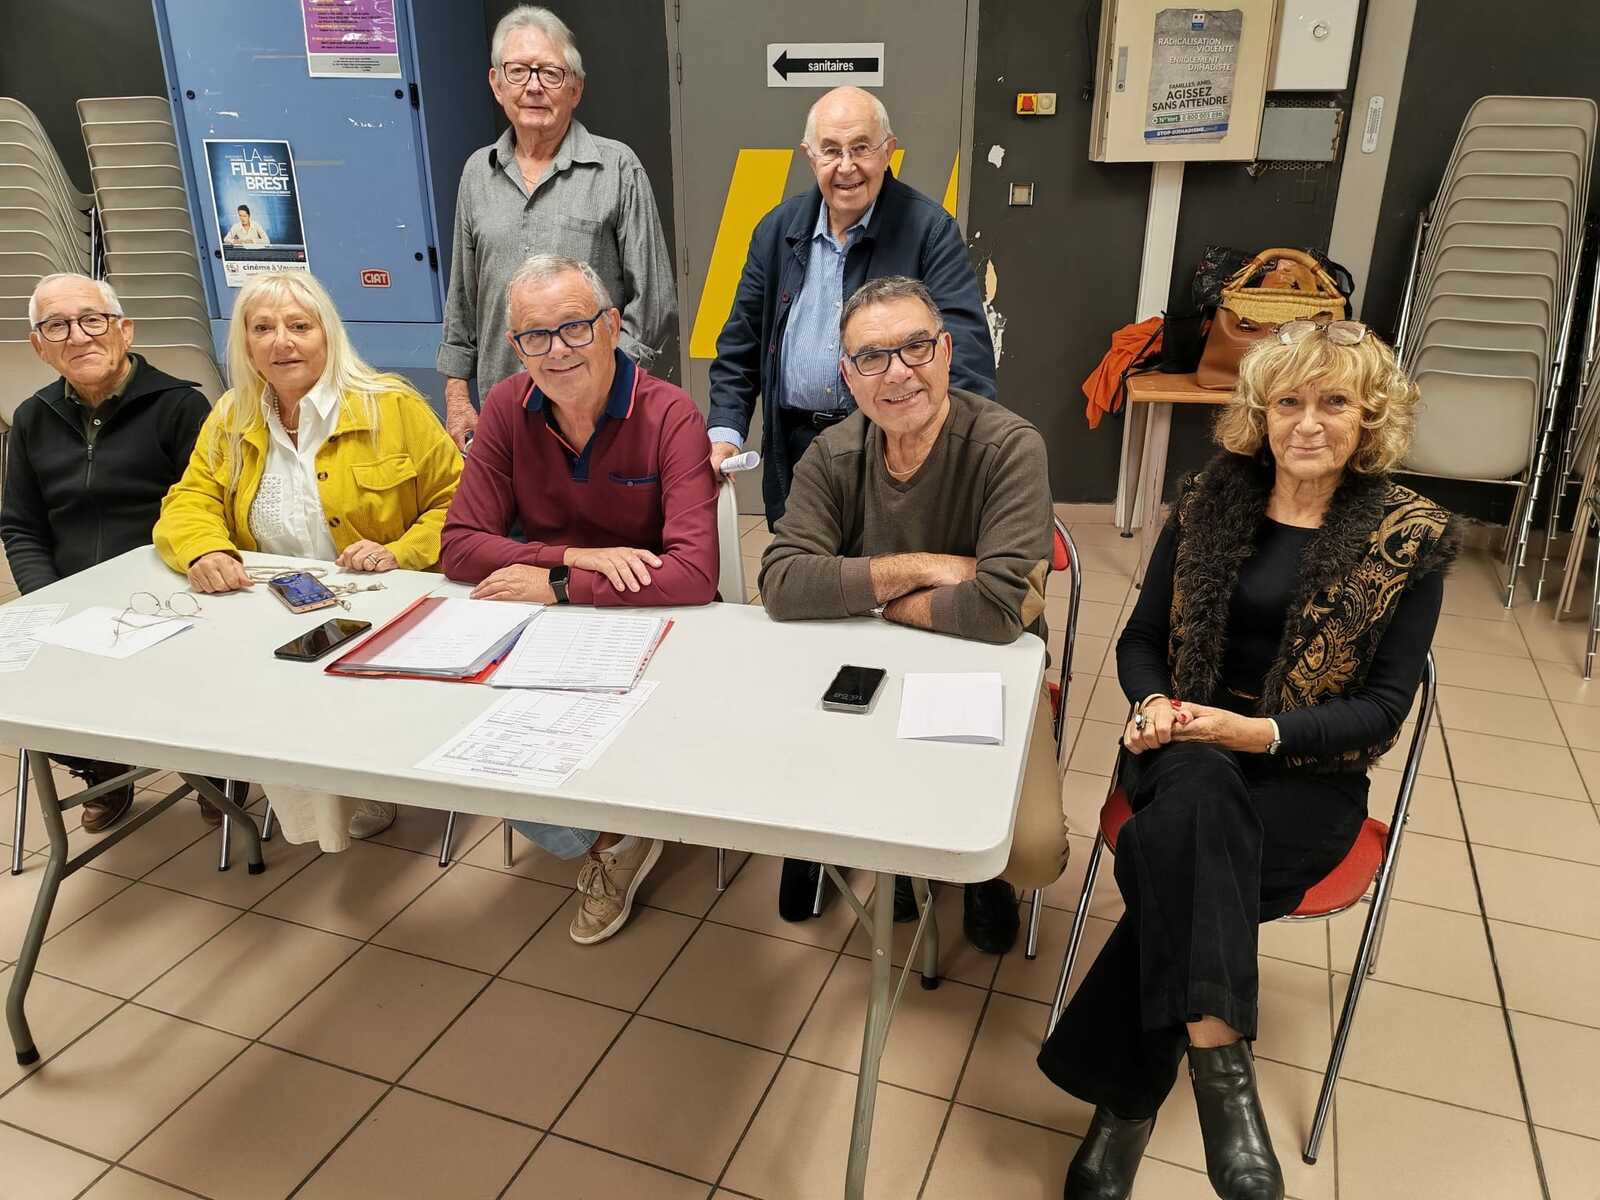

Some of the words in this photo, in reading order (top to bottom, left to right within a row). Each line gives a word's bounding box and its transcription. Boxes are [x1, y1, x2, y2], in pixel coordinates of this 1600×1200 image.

[808, 60, 854, 71] sanitaires
[1166, 87, 1212, 100] AGISSEZ
[1152, 101, 1177, 111] SANS
[1179, 96, 1229, 109] ATTENDRE
[243, 148, 262, 161] LA
[230, 162, 268, 176] FILLE
[268, 163, 288, 176] DE
[245, 177, 289, 190] BREST
[364, 273, 387, 284] CIAT
